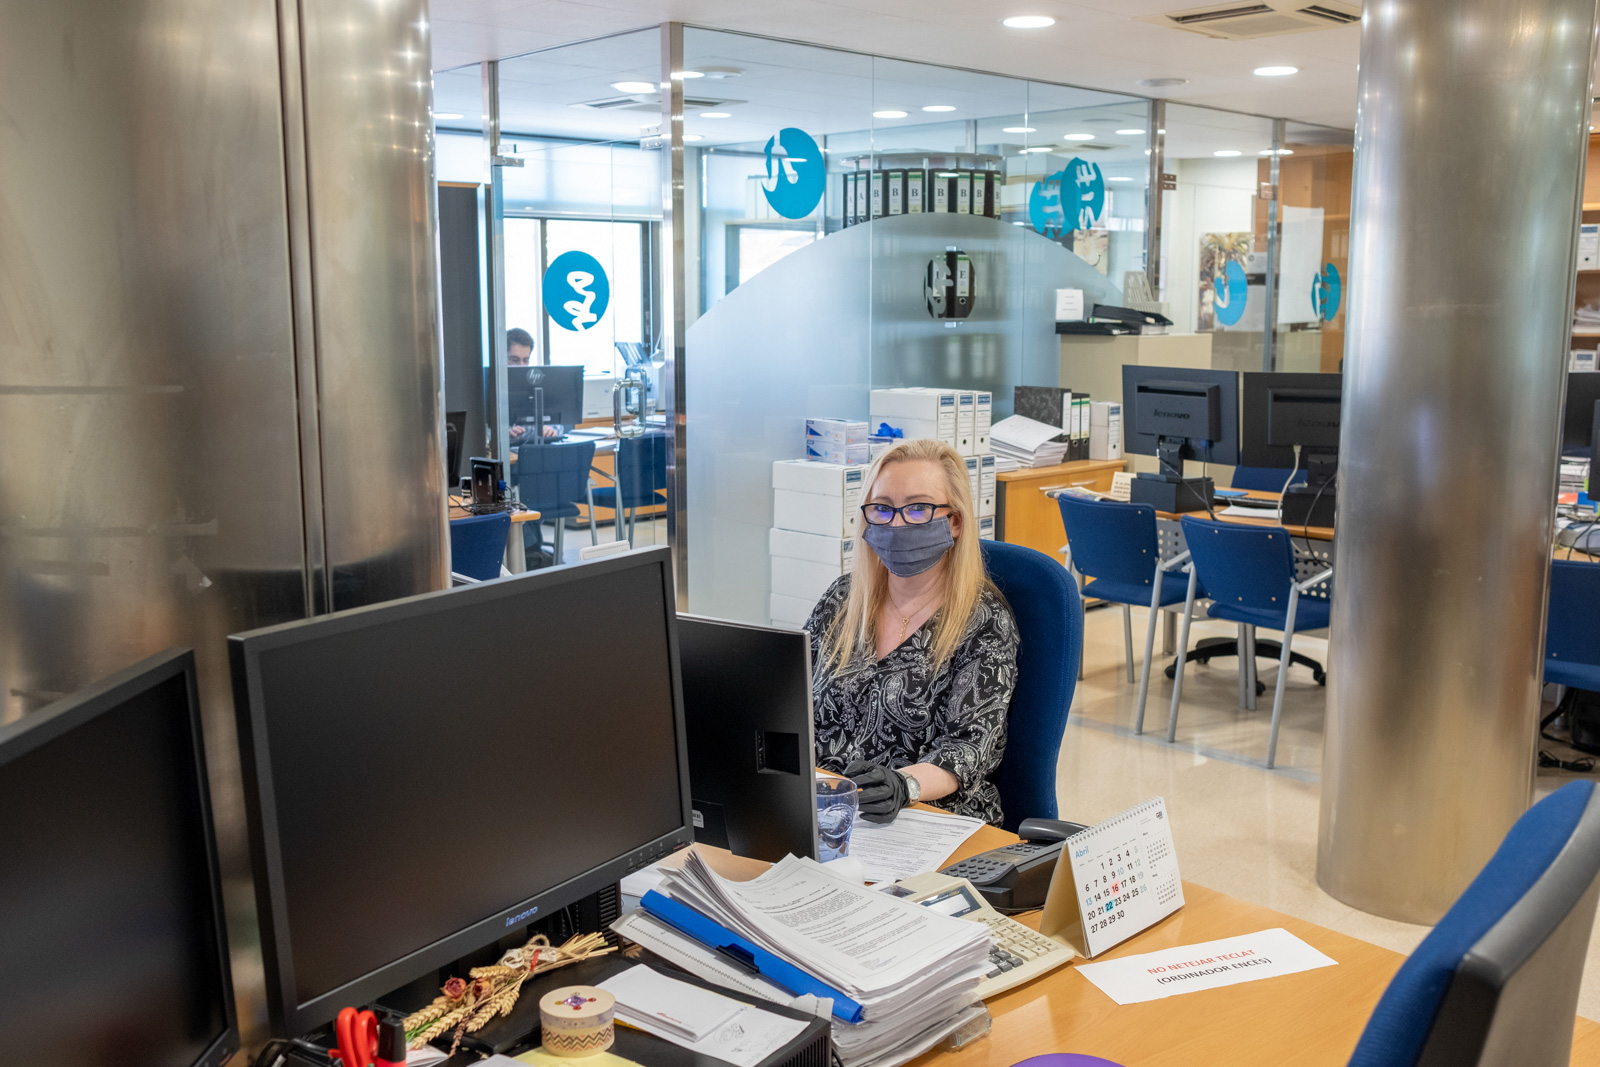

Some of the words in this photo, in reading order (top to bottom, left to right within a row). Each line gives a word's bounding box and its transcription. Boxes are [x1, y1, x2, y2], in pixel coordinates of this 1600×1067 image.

[858, 191, 864, 200] A
[873, 189, 879, 197] B
[892, 188, 899, 196] B
[911, 188, 918, 197] B
[937, 188, 944, 197] B
[960, 188, 967, 197] B
[976, 189, 982, 197] B
[960, 270, 966, 279] E
[1153, 408, 1190, 420] lenovo
[1296, 418, 1340, 428] lenov
[1075, 846, 1089, 859] Abril
[1118, 867, 1124, 876] 10
[1135, 859, 1141, 867] 12
[1086, 898, 1092, 906] 13
[1112, 884, 1119, 892] 16
[1130, 876, 1136, 884] 18
[1088, 911, 1096, 920] 20
[1098, 906, 1104, 915] 21
[1105, 902, 1113, 910] 22
[1115, 898, 1121, 906] 23
[1123, 894, 1130, 902] 24
[1132, 888, 1139, 897] 25
[1140, 884, 1147, 892] 26
[505, 905, 538, 927] lenovo
[1091, 924, 1097, 933] 27
[1100, 920, 1107, 928] 28
[1109, 915, 1115, 924] 29
[1117, 910, 1124, 919] 30
[1147, 966, 1166, 974] NO
[1168, 958, 1215, 970] NETEJAR
[1215, 950, 1256, 961] TECLAT
[1157, 965, 1232, 984] (ORDINADOR
[1234, 957, 1273, 970] ENCÈS)
